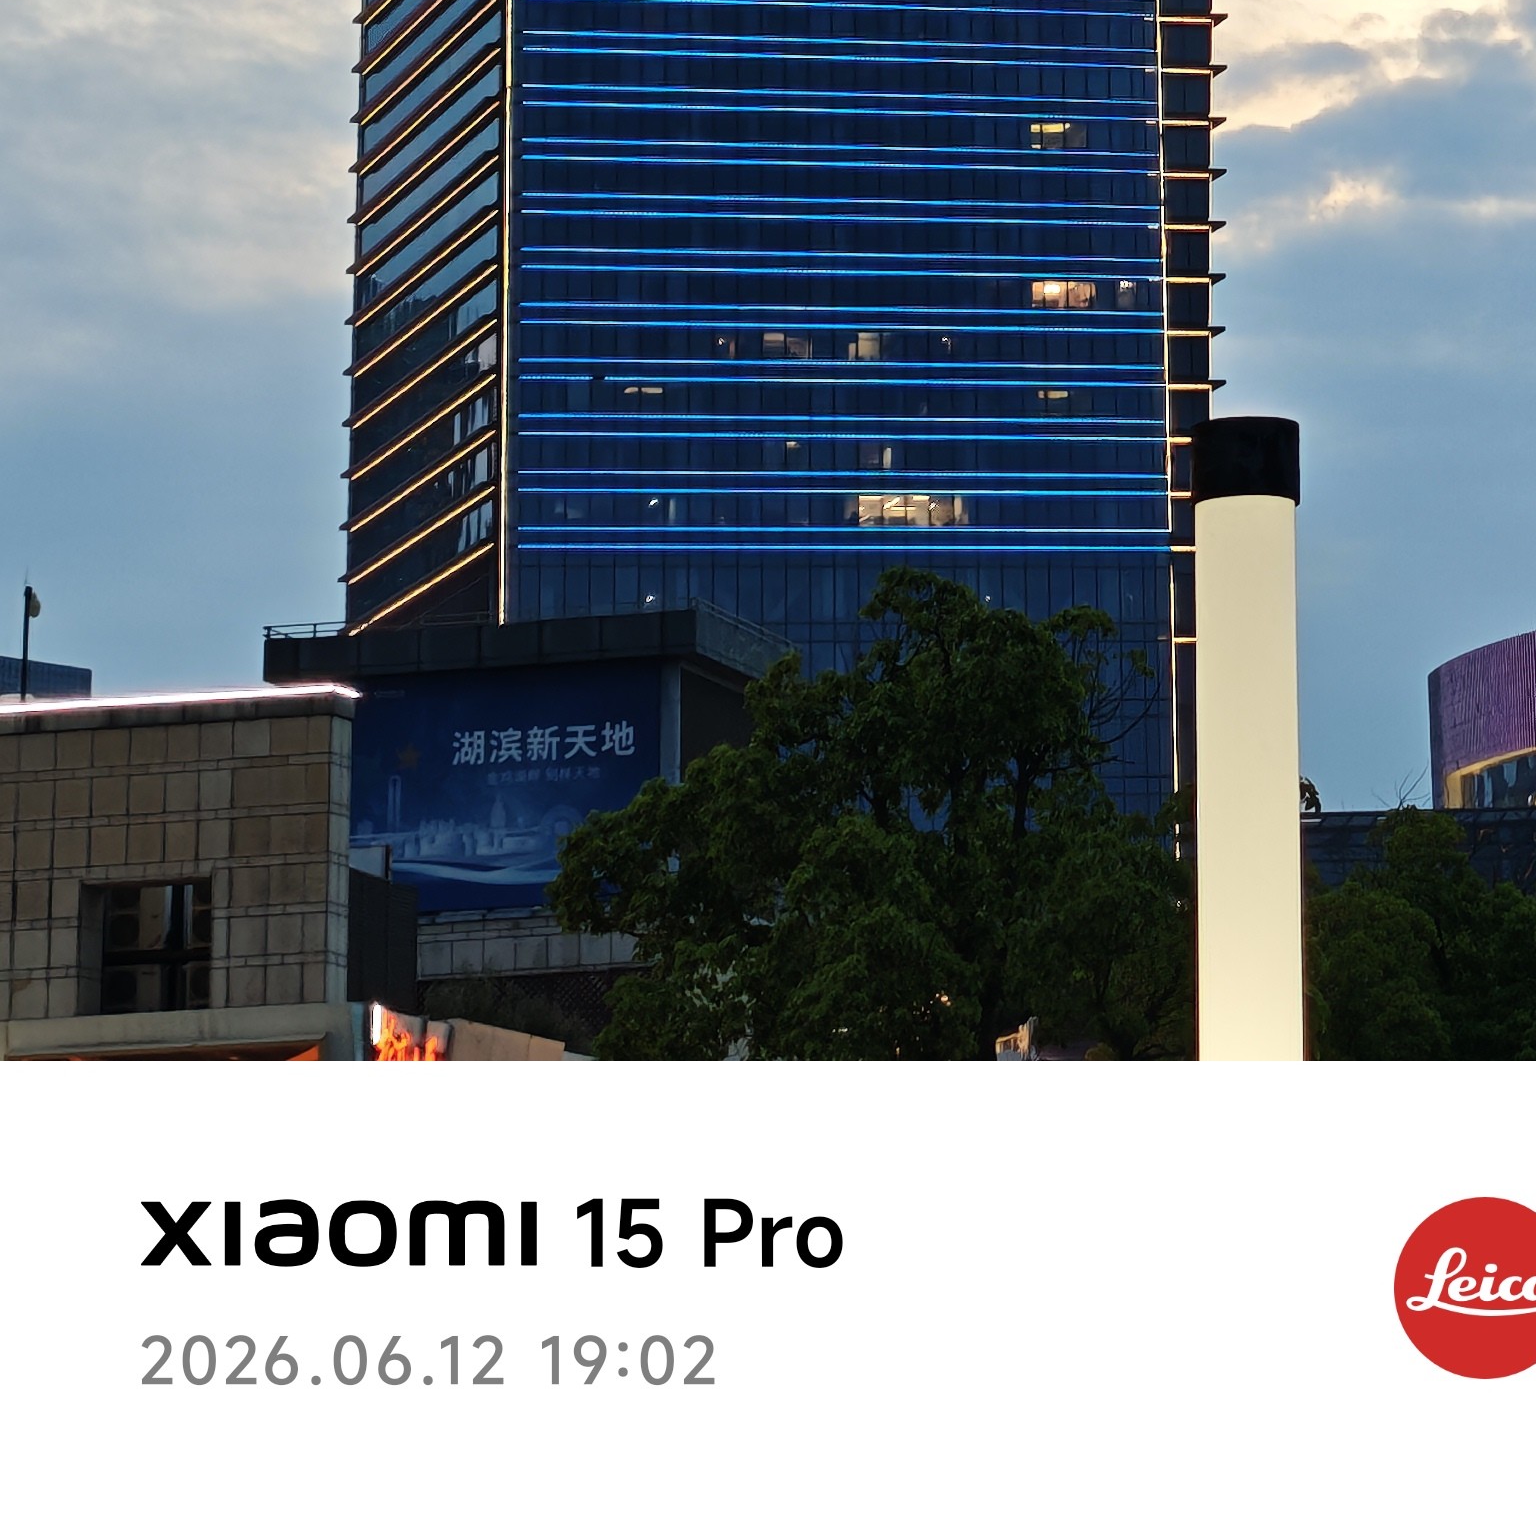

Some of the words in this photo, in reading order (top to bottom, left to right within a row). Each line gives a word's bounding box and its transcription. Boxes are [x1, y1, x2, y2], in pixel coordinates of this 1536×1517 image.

[452, 720, 635, 766] 湖滨新天地
